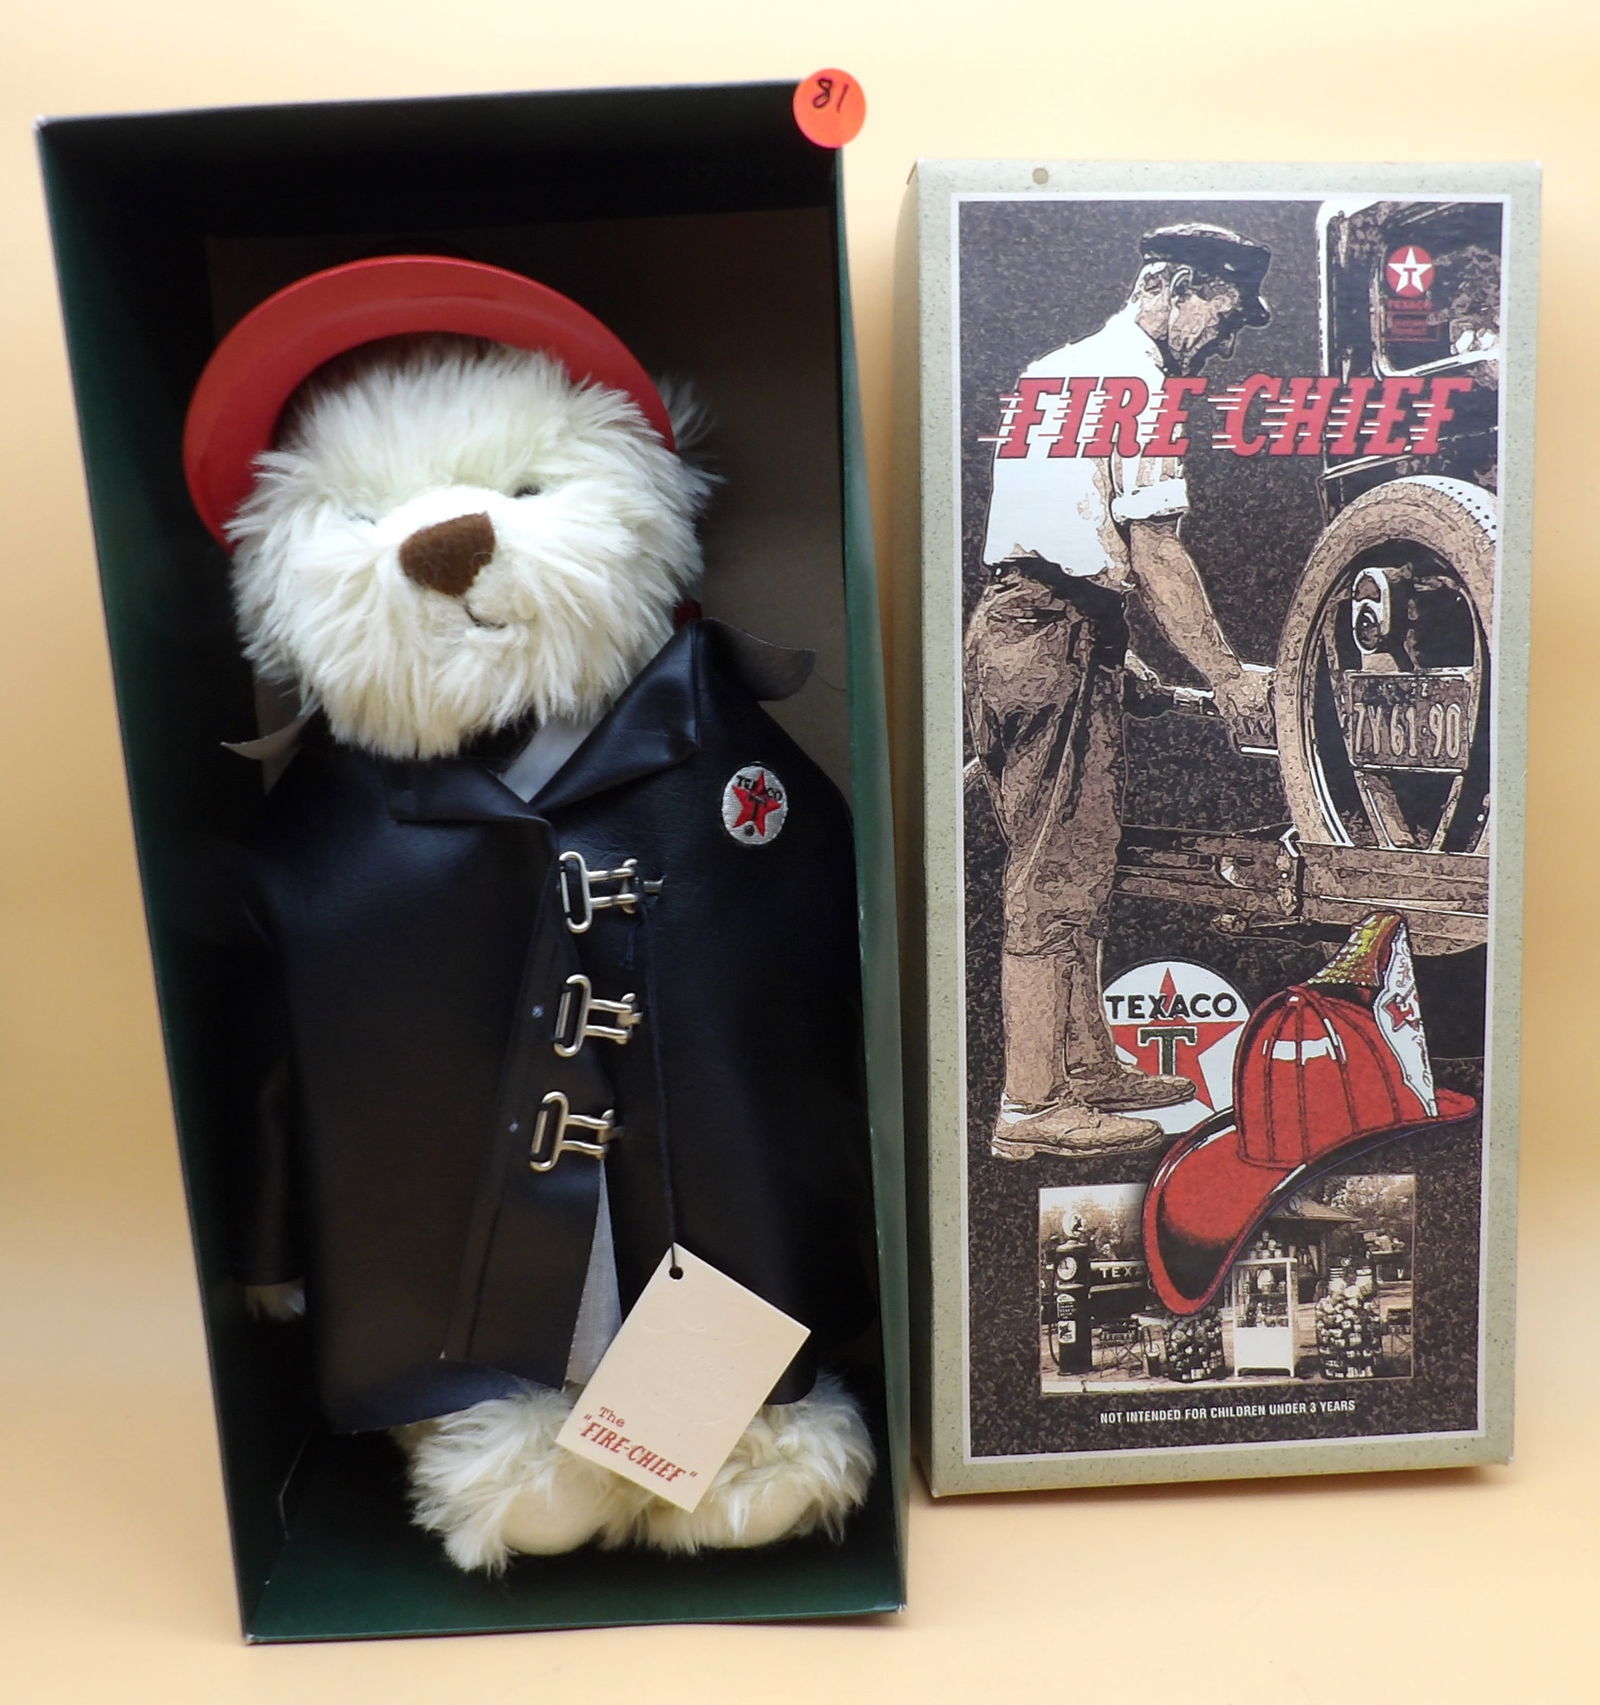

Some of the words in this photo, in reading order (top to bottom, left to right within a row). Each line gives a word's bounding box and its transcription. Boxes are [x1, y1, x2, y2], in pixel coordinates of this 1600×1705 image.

[812, 77, 849, 114] 81
[984, 376, 1208, 459] FIRE
[1212, 373, 1474, 457] CHIEF
[1429, 703, 1461, 758] 90
[736, 775, 783, 802] TECO
[1105, 992, 1237, 1019] TEXACO
[1138, 1026, 1197, 1076] T
[598, 1406, 626, 1428] The
[1100, 1411, 1123, 1424] NOT
[1126, 1409, 1181, 1423] INTENDED
[1184, 1407, 1207, 1420] FOR
[1210, 1405, 1266, 1419] CHILDREN
[1269, 1402, 1306, 1415] UNDER
[1309, 1402, 1317, 1413] 3
[1320, 1399, 1356, 1412] YEARS
[580, 1413, 699, 1482] "FIRE-CHIEF"
